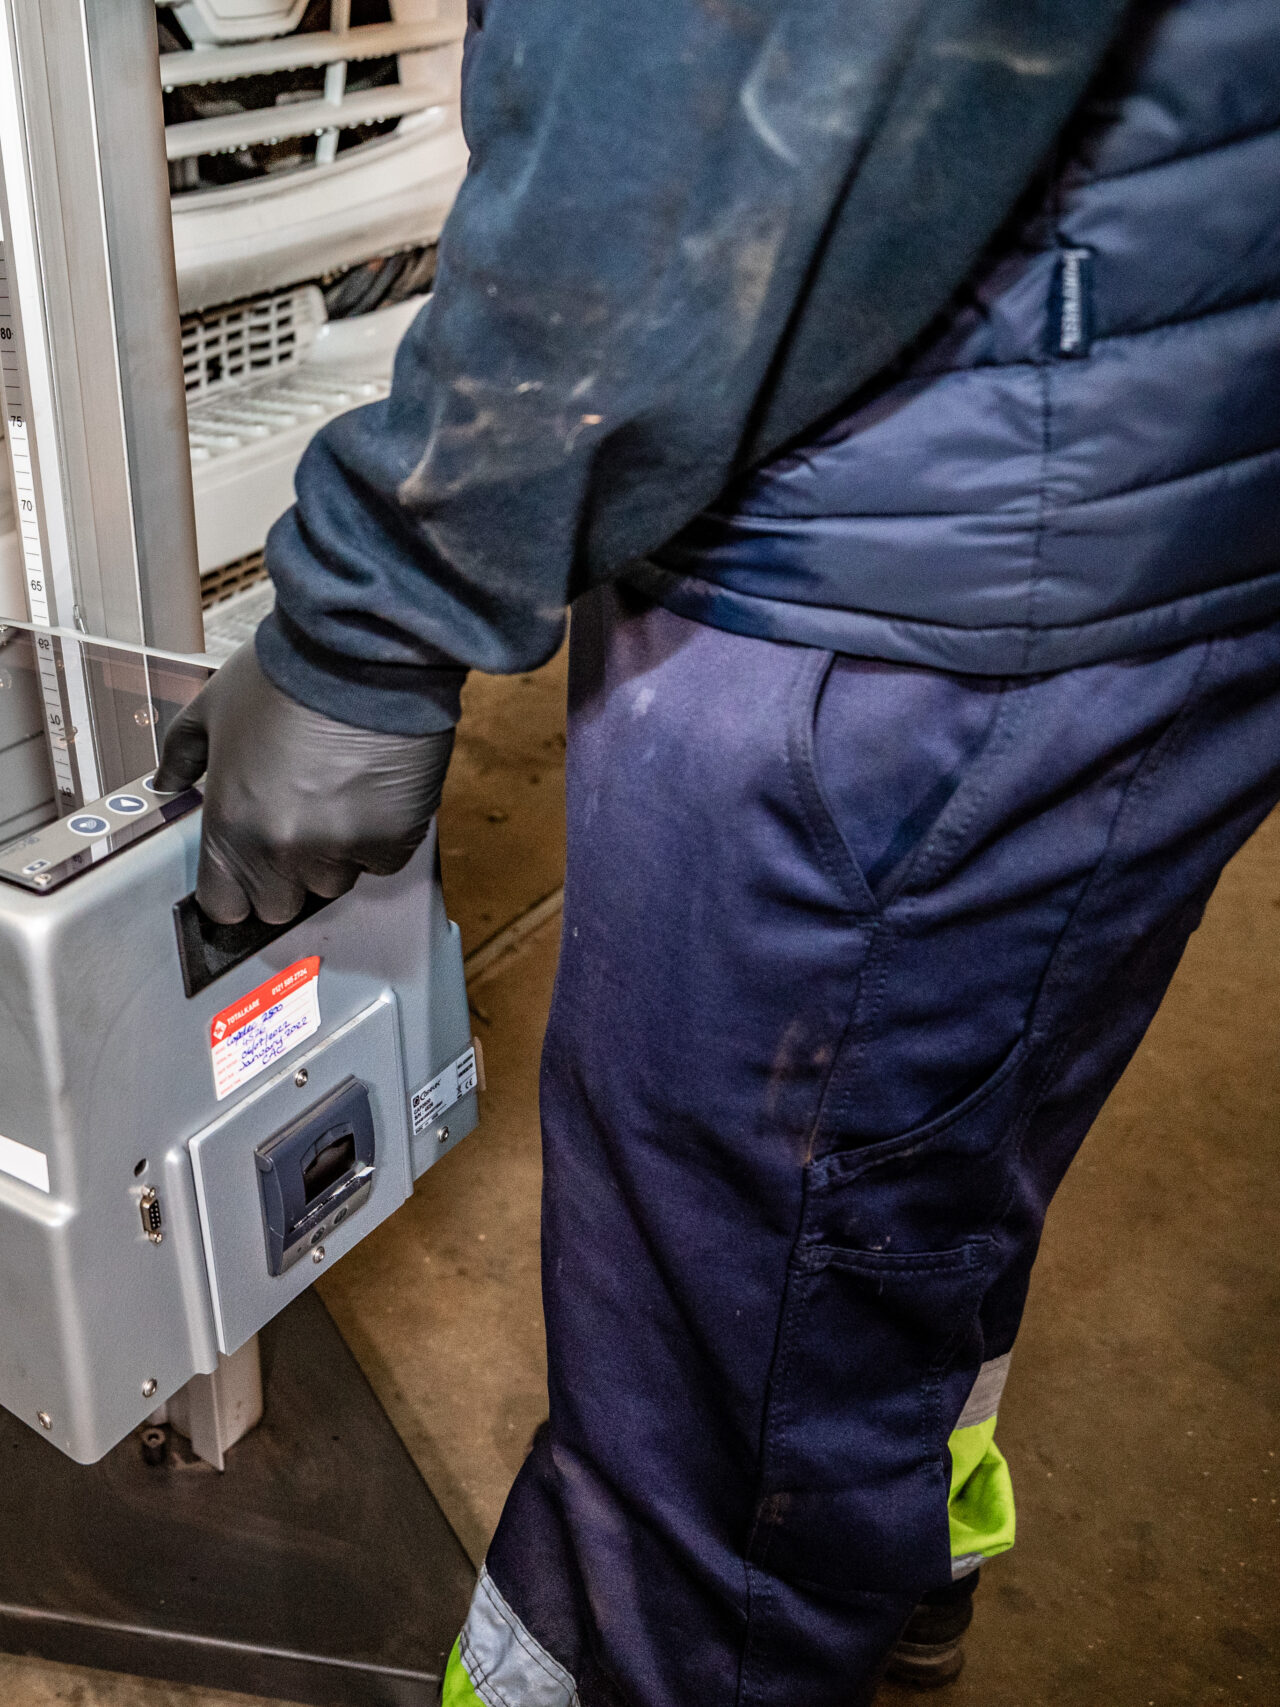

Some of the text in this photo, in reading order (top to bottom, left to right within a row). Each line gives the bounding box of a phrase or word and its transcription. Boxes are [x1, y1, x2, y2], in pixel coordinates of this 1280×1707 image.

[0, 327, 12, 340] 80
[10, 415, 24, 428] 75
[20, 499, 33, 512] 70
[30, 579, 43, 592] 65
[227, 998, 260, 1025] TOTALKARE
